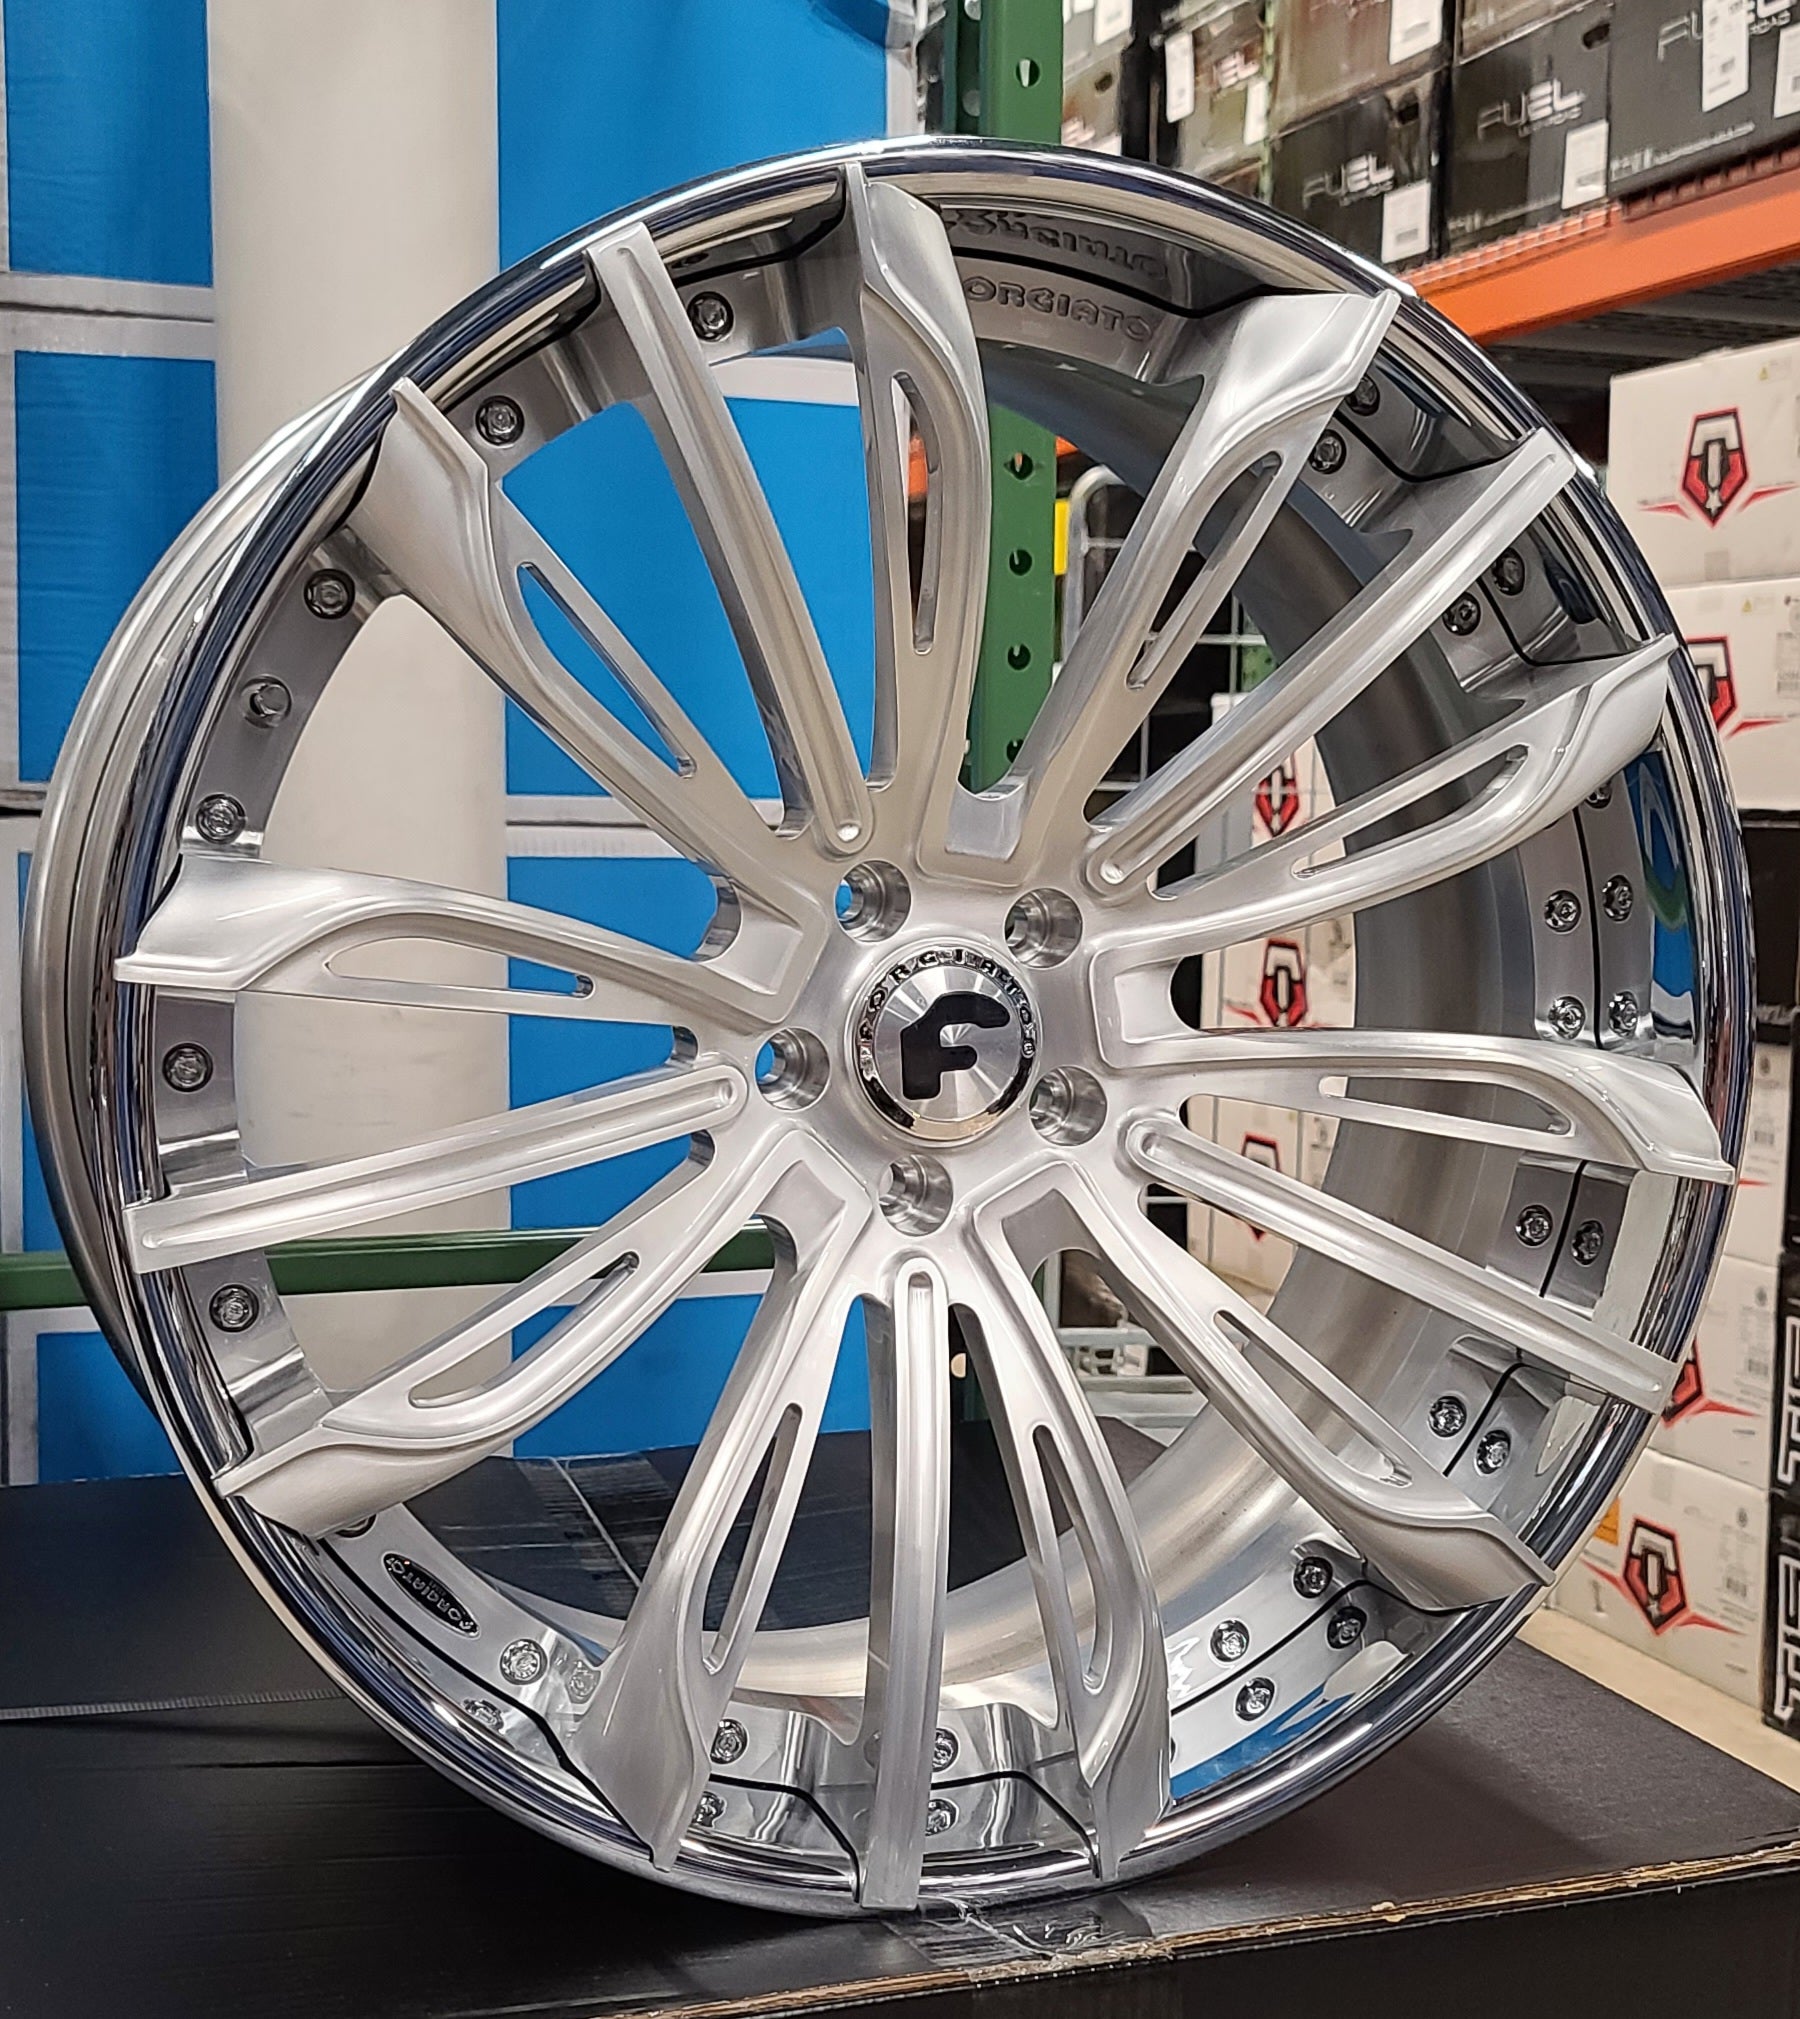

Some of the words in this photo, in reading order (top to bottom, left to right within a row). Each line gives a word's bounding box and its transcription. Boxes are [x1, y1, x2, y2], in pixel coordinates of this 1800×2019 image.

[1477, 78, 1586, 141] FUEL
[1302, 153, 1395, 210] FUEL
[962, 276, 1152, 342] ORGIATO
